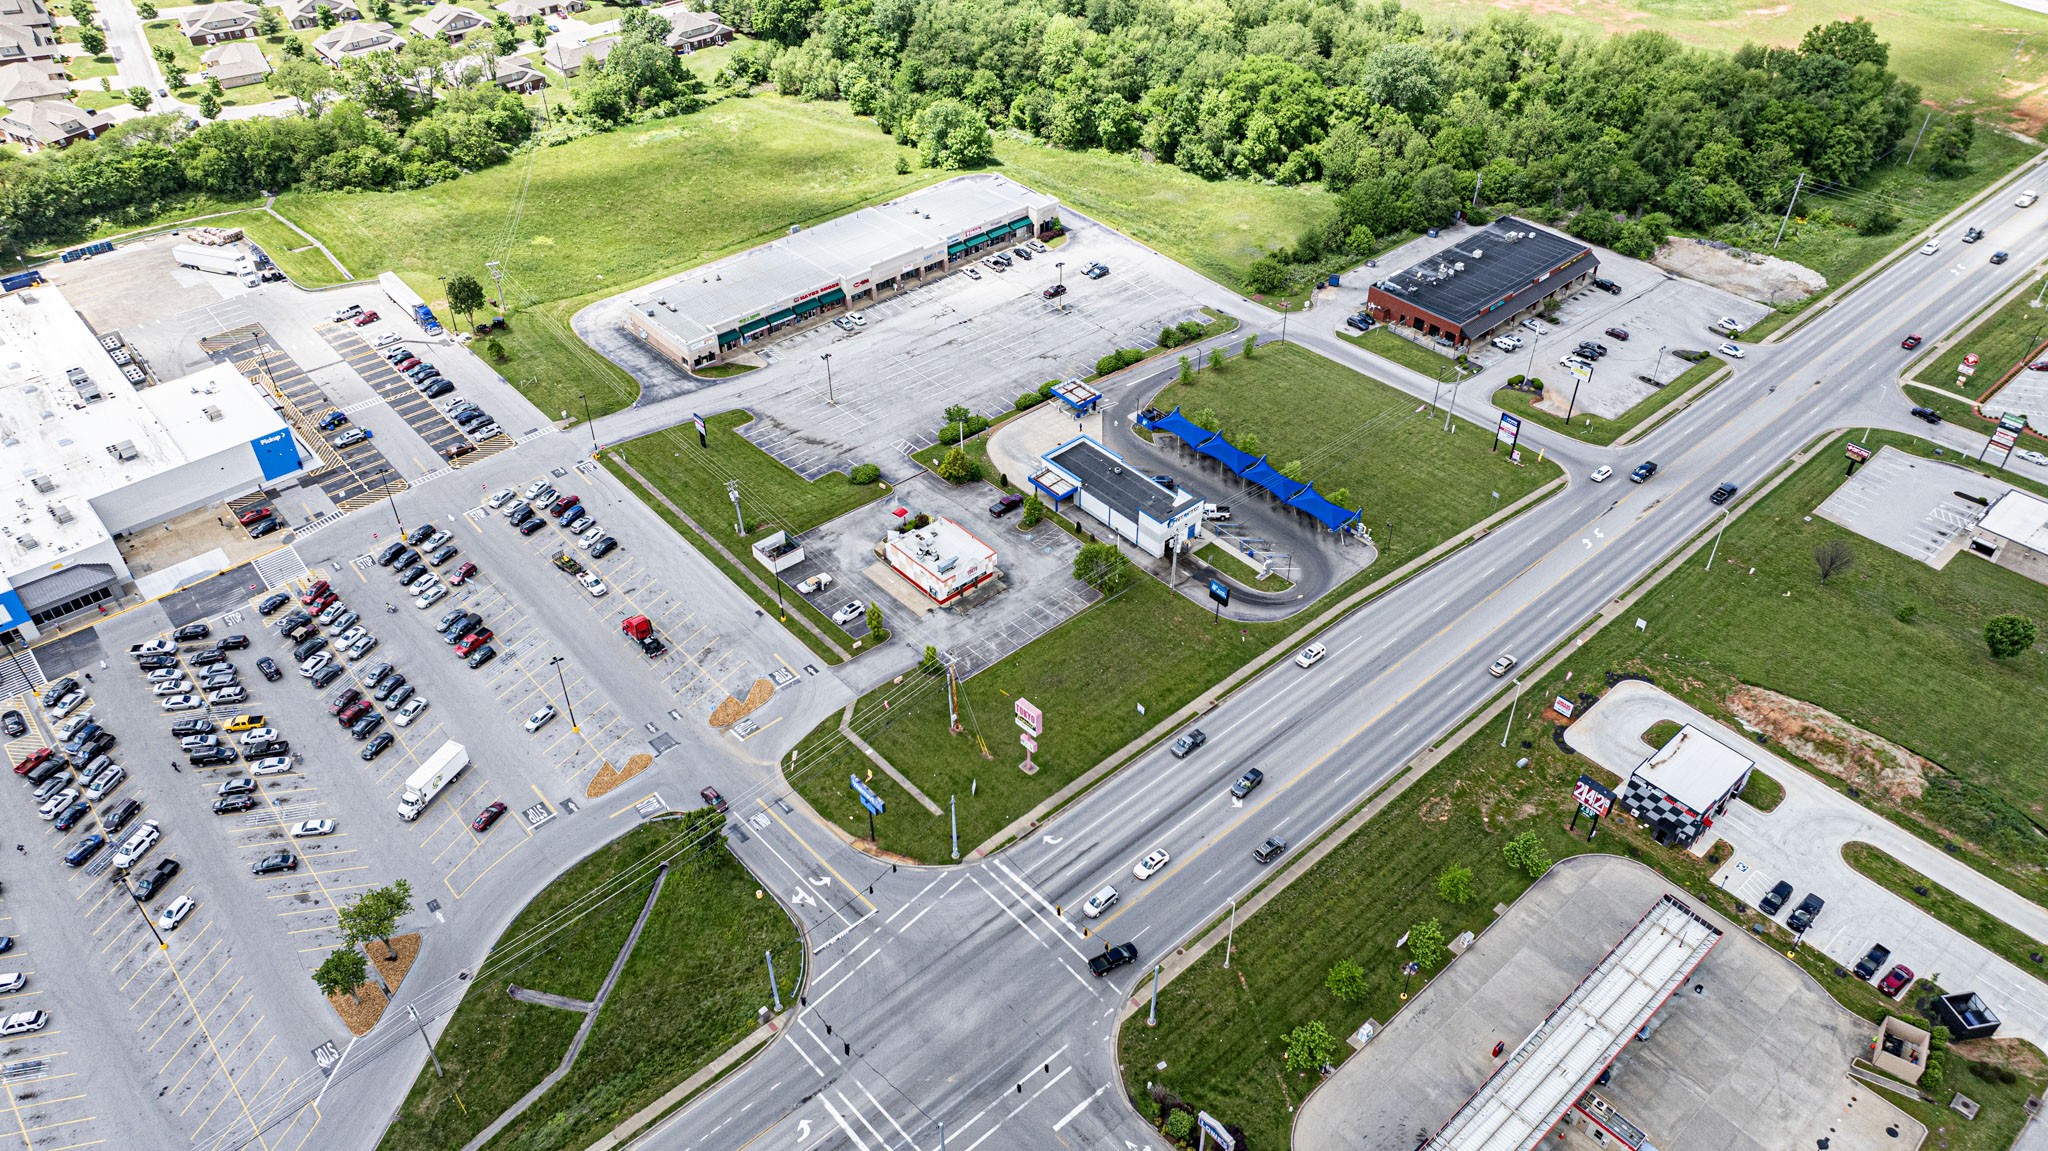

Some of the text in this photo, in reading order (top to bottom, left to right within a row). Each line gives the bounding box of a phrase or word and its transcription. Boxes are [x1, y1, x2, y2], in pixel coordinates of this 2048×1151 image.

[260, 435, 281, 446] Pickup
[580, 461, 596, 474] STOP
[469, 506, 488, 520] STOP
[356, 556, 374, 570] STOP
[224, 611, 242, 626] STOP
[772, 668, 794, 683] STOP
[1016, 703, 1036, 724] TOKYO
[528, 804, 548, 823] STOP
[314, 1042, 339, 1068] STOP
